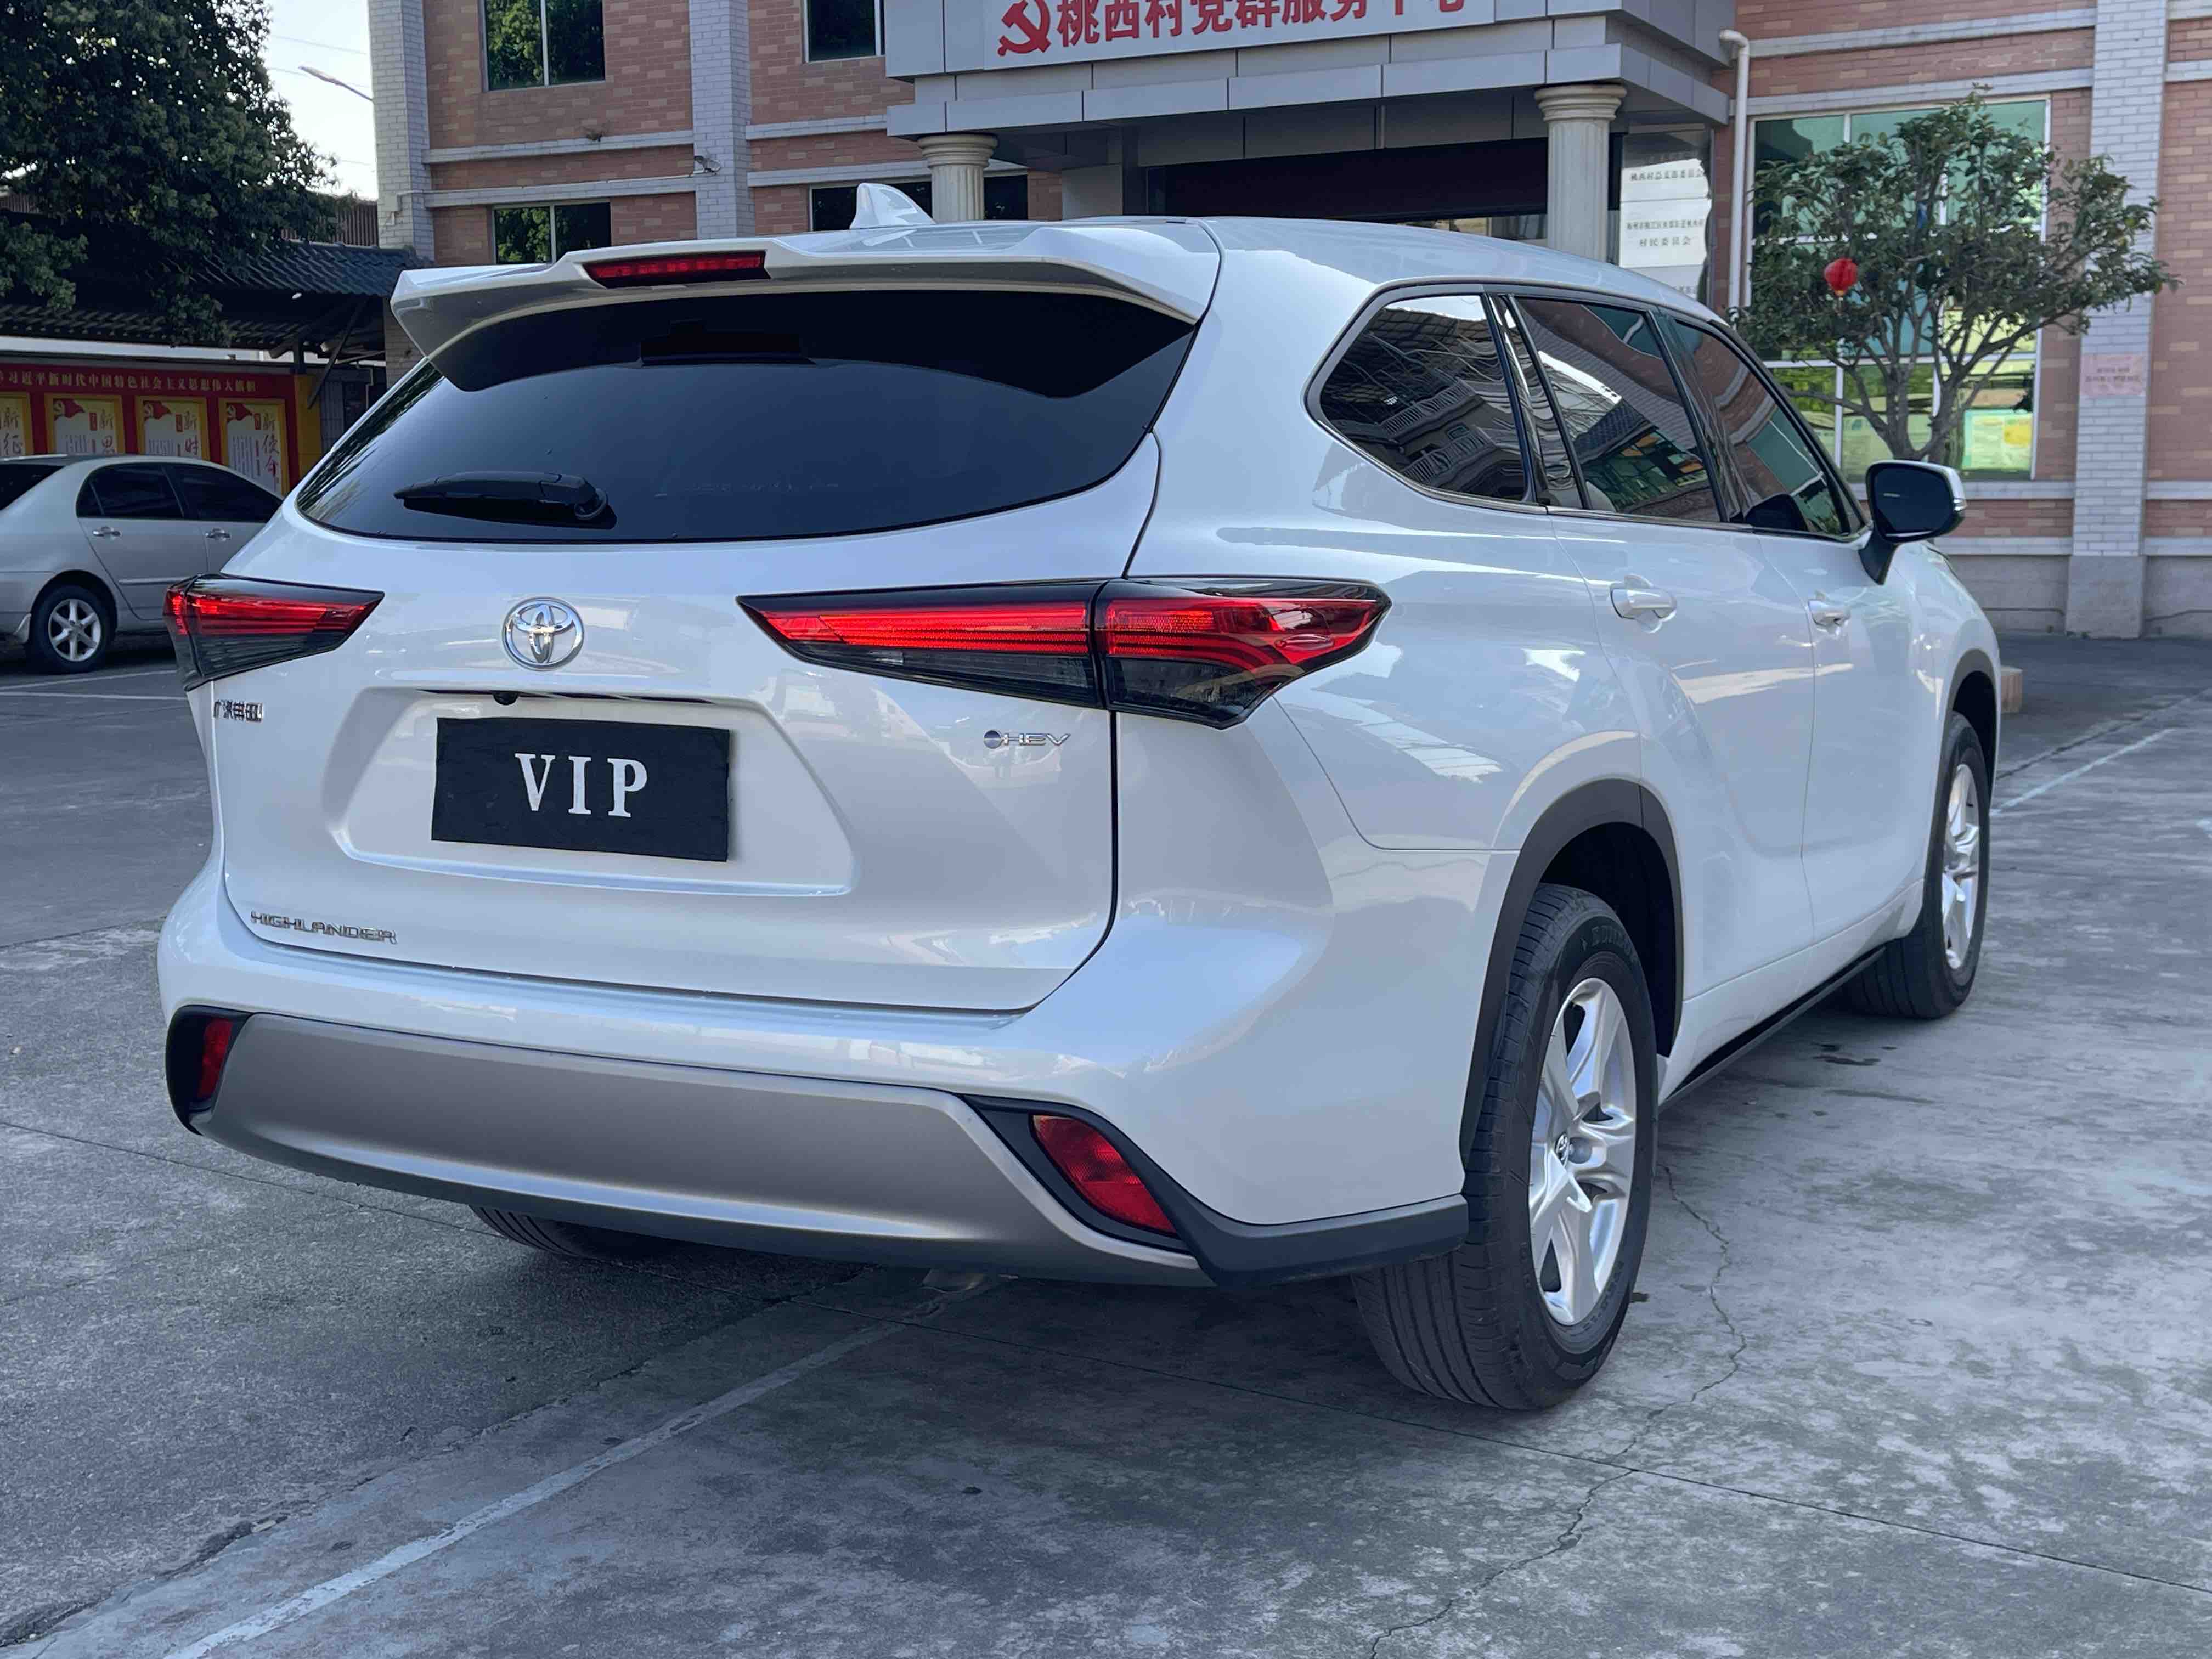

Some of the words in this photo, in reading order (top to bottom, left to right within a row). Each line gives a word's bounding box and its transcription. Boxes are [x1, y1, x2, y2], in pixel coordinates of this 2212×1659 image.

[1057, 0, 1464, 47] 桃西村党群服
[1003, 733, 1071, 746] HEV
[515, 753, 648, 817] VIP
[250, 911, 398, 944] HIGHLANDER
